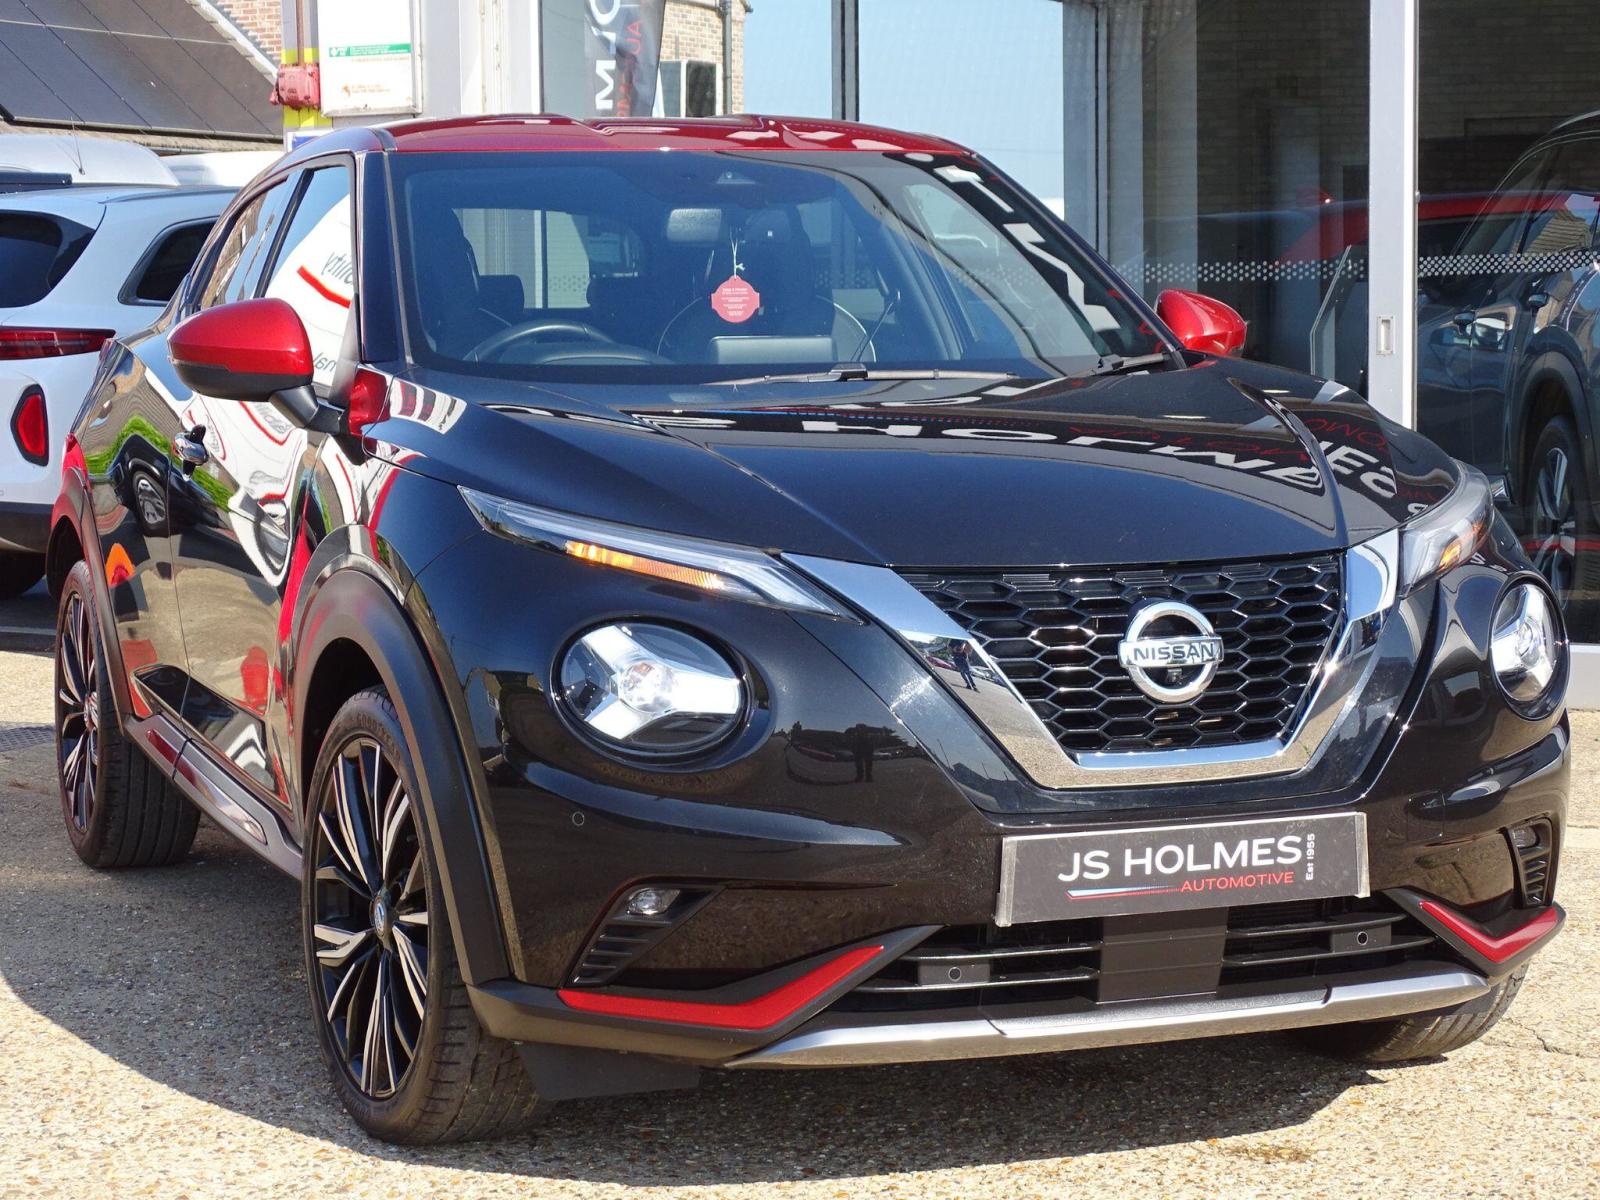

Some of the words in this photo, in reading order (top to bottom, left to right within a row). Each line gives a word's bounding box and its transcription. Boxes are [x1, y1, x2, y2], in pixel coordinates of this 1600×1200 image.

[1133, 643, 1214, 661] NISSAN
[1306, 833, 1315, 860] 1955
[1058, 850, 1109, 882] JS
[1124, 835, 1302, 877] HOLMES
[1181, 871, 1295, 893] AUTOMOTIVE
[1305, 862, 1314, 880] Est
